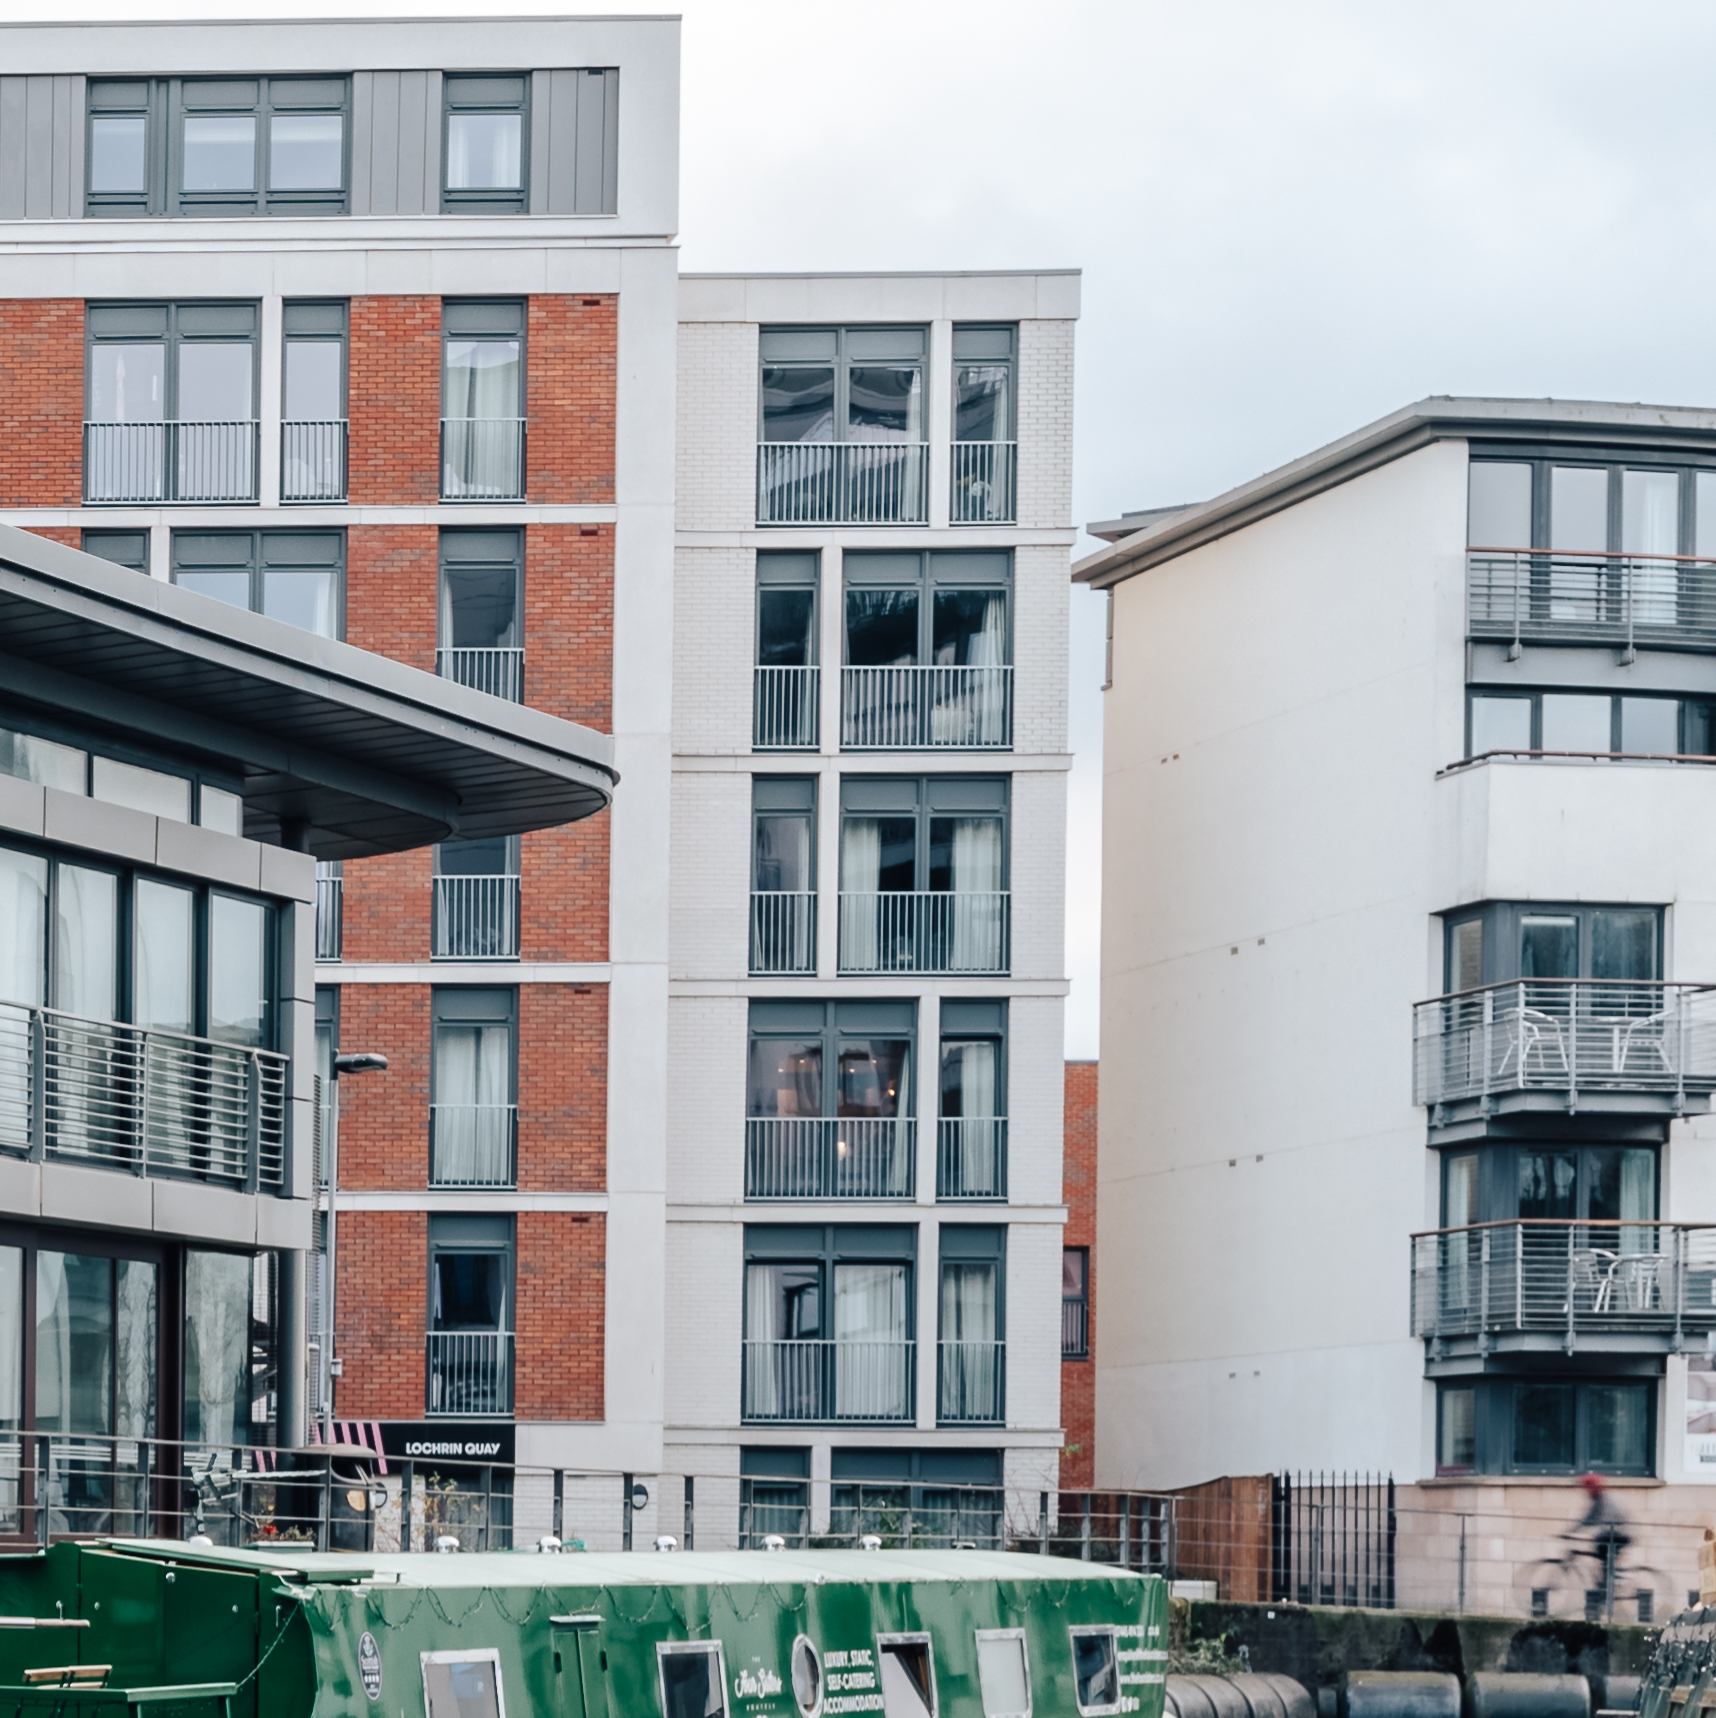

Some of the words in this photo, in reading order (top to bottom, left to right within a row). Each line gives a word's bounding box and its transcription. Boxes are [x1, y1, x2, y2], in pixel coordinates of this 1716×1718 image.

[405, 1442, 462, 1455] LOCHRIN
[464, 1442, 501, 1455] QUAY
[826, 1672, 876, 1691] SELF-CATERING
[822, 1694, 885, 1715] ACCOMMODATION
